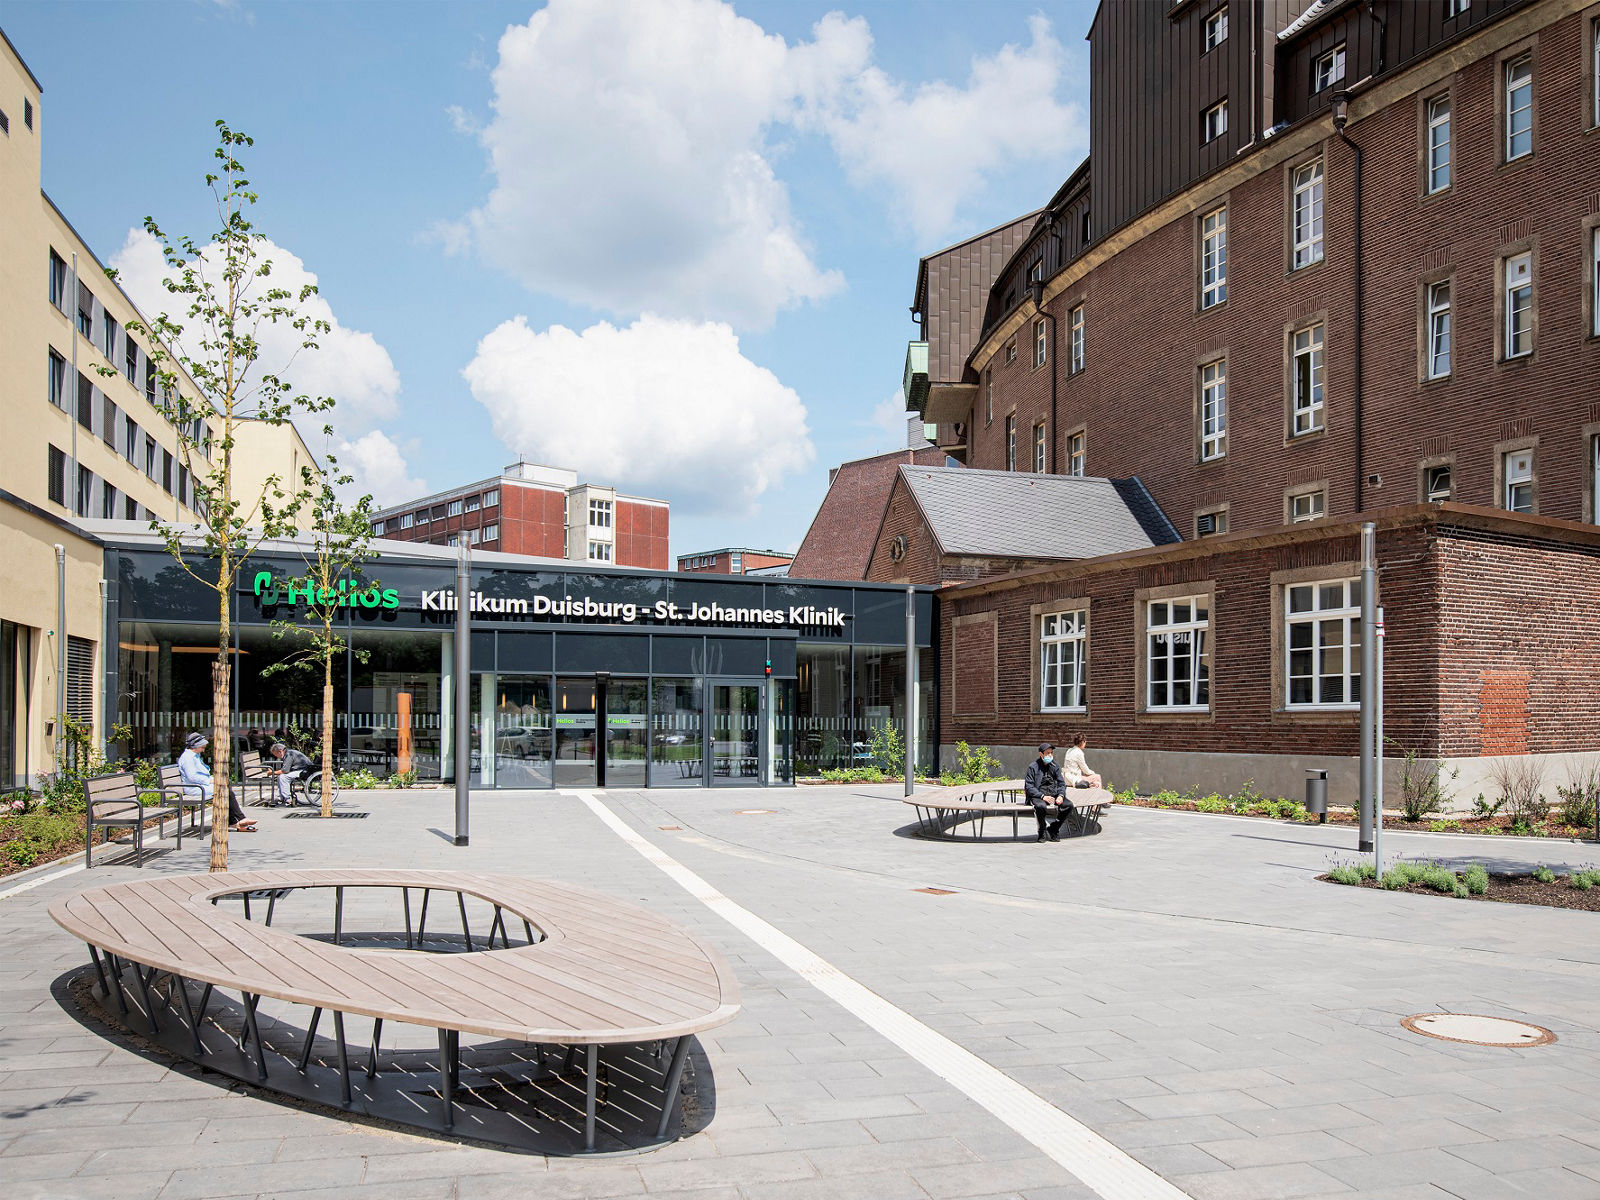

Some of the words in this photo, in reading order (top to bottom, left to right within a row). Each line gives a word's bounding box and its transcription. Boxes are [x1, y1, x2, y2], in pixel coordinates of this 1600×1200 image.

[288, 579, 399, 608] Helios
[533, 595, 636, 622] Duisburg
[655, 600, 683, 620] St.
[687, 602, 784, 624] Johannes
[789, 606, 846, 627] Klinik
